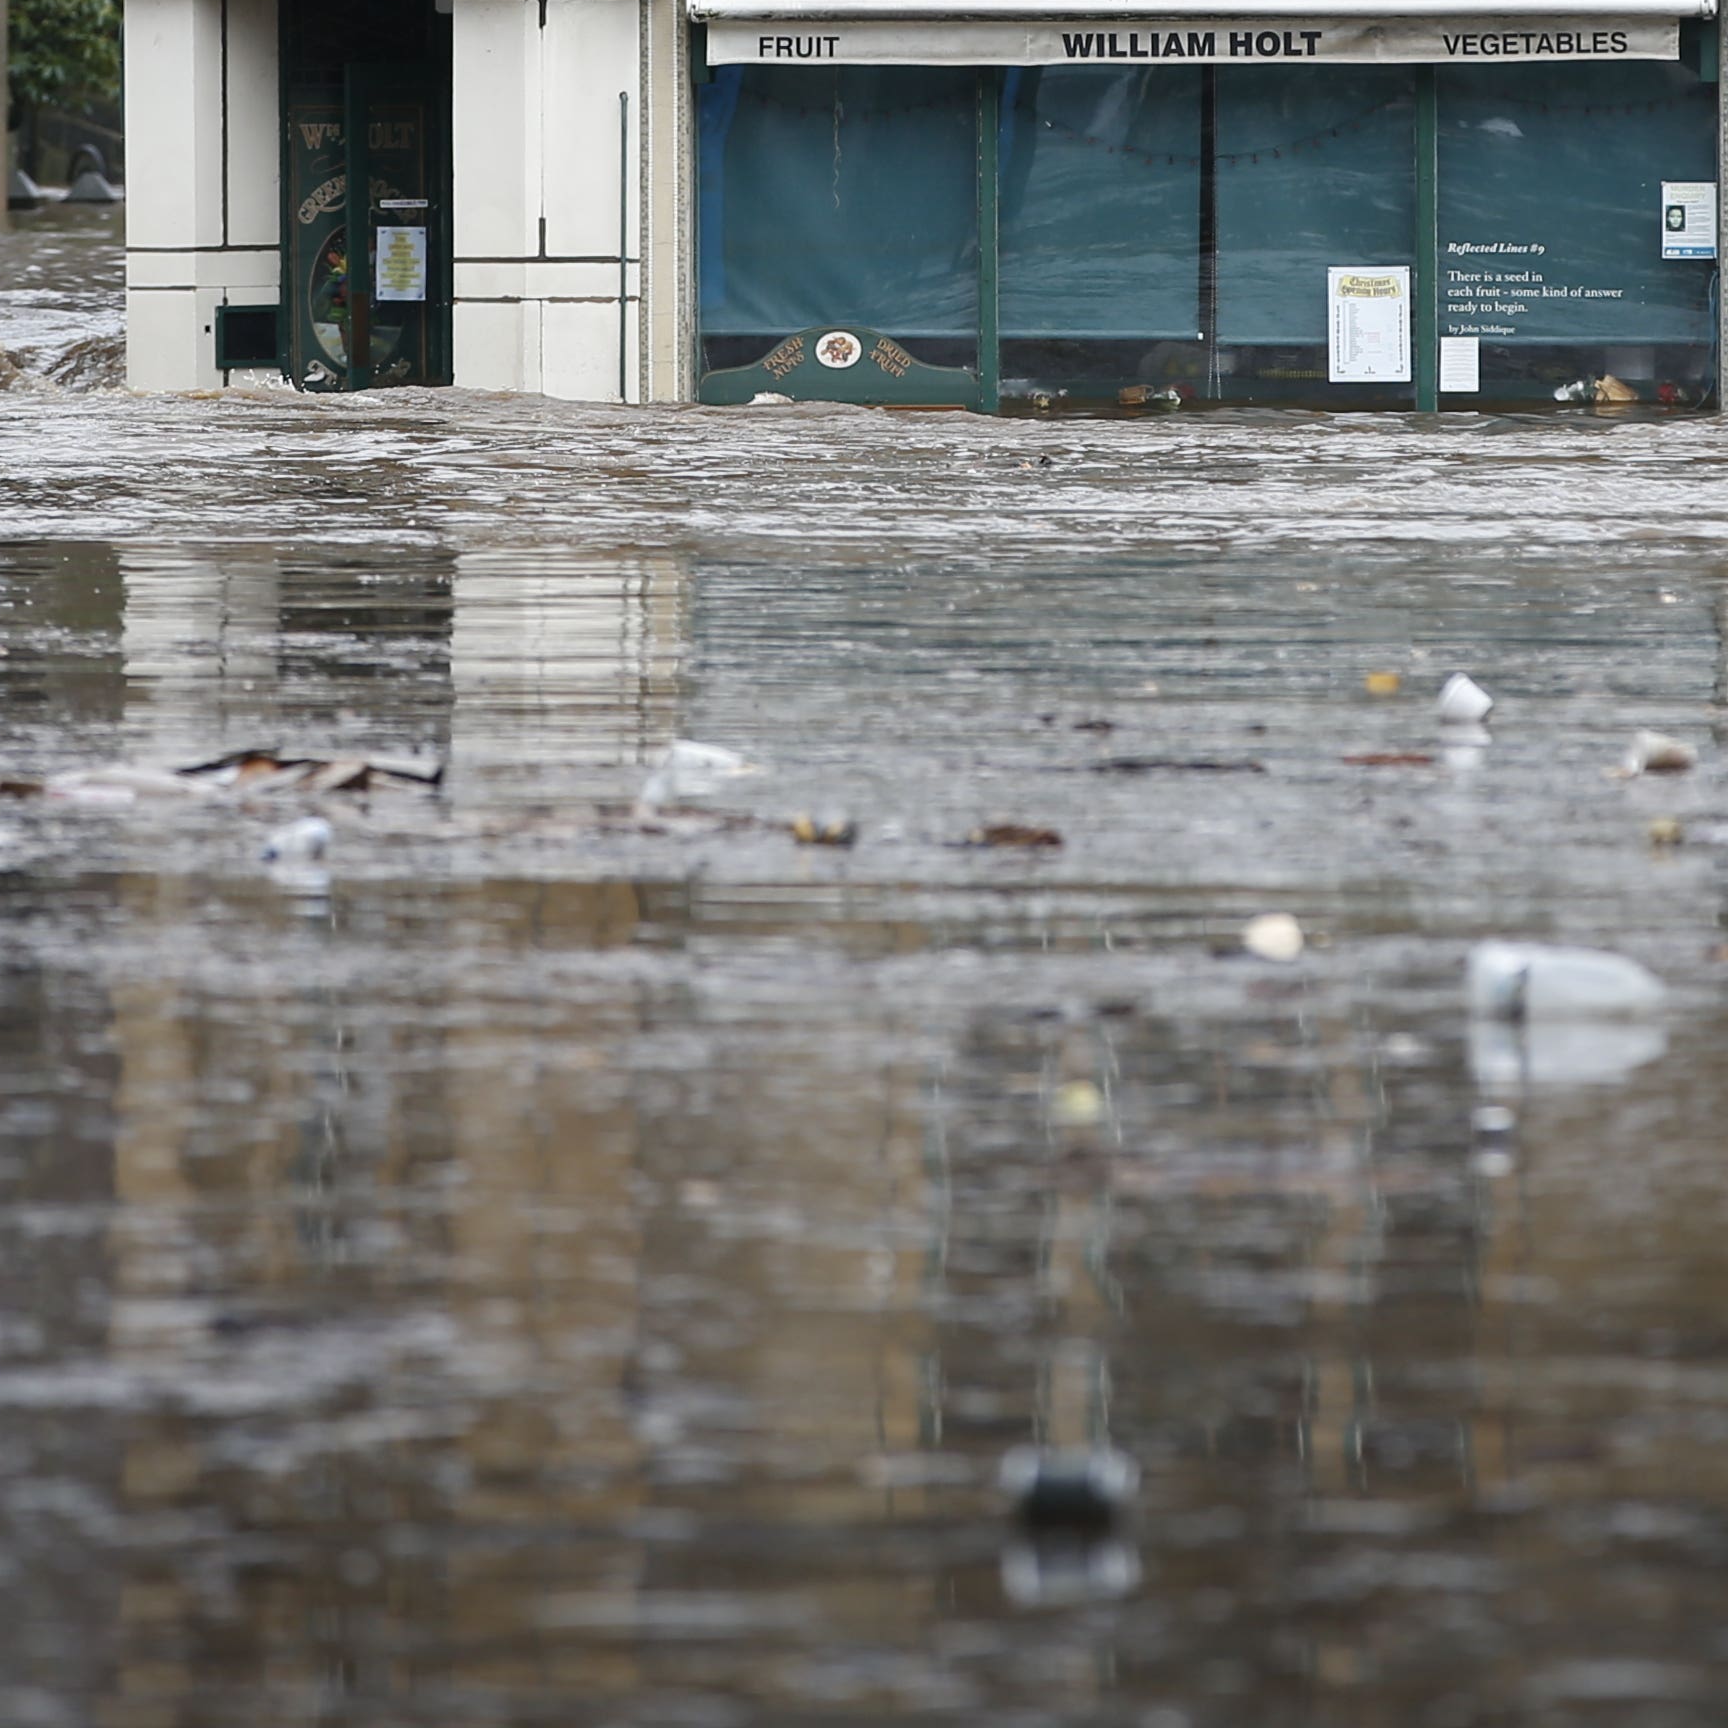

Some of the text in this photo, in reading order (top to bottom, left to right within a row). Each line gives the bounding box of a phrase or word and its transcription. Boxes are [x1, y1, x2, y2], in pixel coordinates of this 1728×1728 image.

[758, 31, 1628, 58] FRUIT WILLIAM HOLT VEGETABLES
[1447, 243, 1545, 256] Reflected Lines #9
[1447, 270, 1543, 282] There is a seed in
[1447, 286, 1473, 297] each
[1476, 286, 1500, 297] fruit
[1511, 288, 1540, 297] some
[1542, 286, 1568, 297] kind
[1570, 286, 1584, 297] of
[1584, 289, 1623, 298] answer
[1447, 301, 1528, 315] ready to begin.
[1449, 324, 1459, 335] by
[1459, 324, 1479, 335] John
[763, 336, 804, 370] FRESH
[876, 338, 913, 368] DRIED
[773, 351, 805, 380] NUTS
[869, 350, 907, 378] FRUIT
